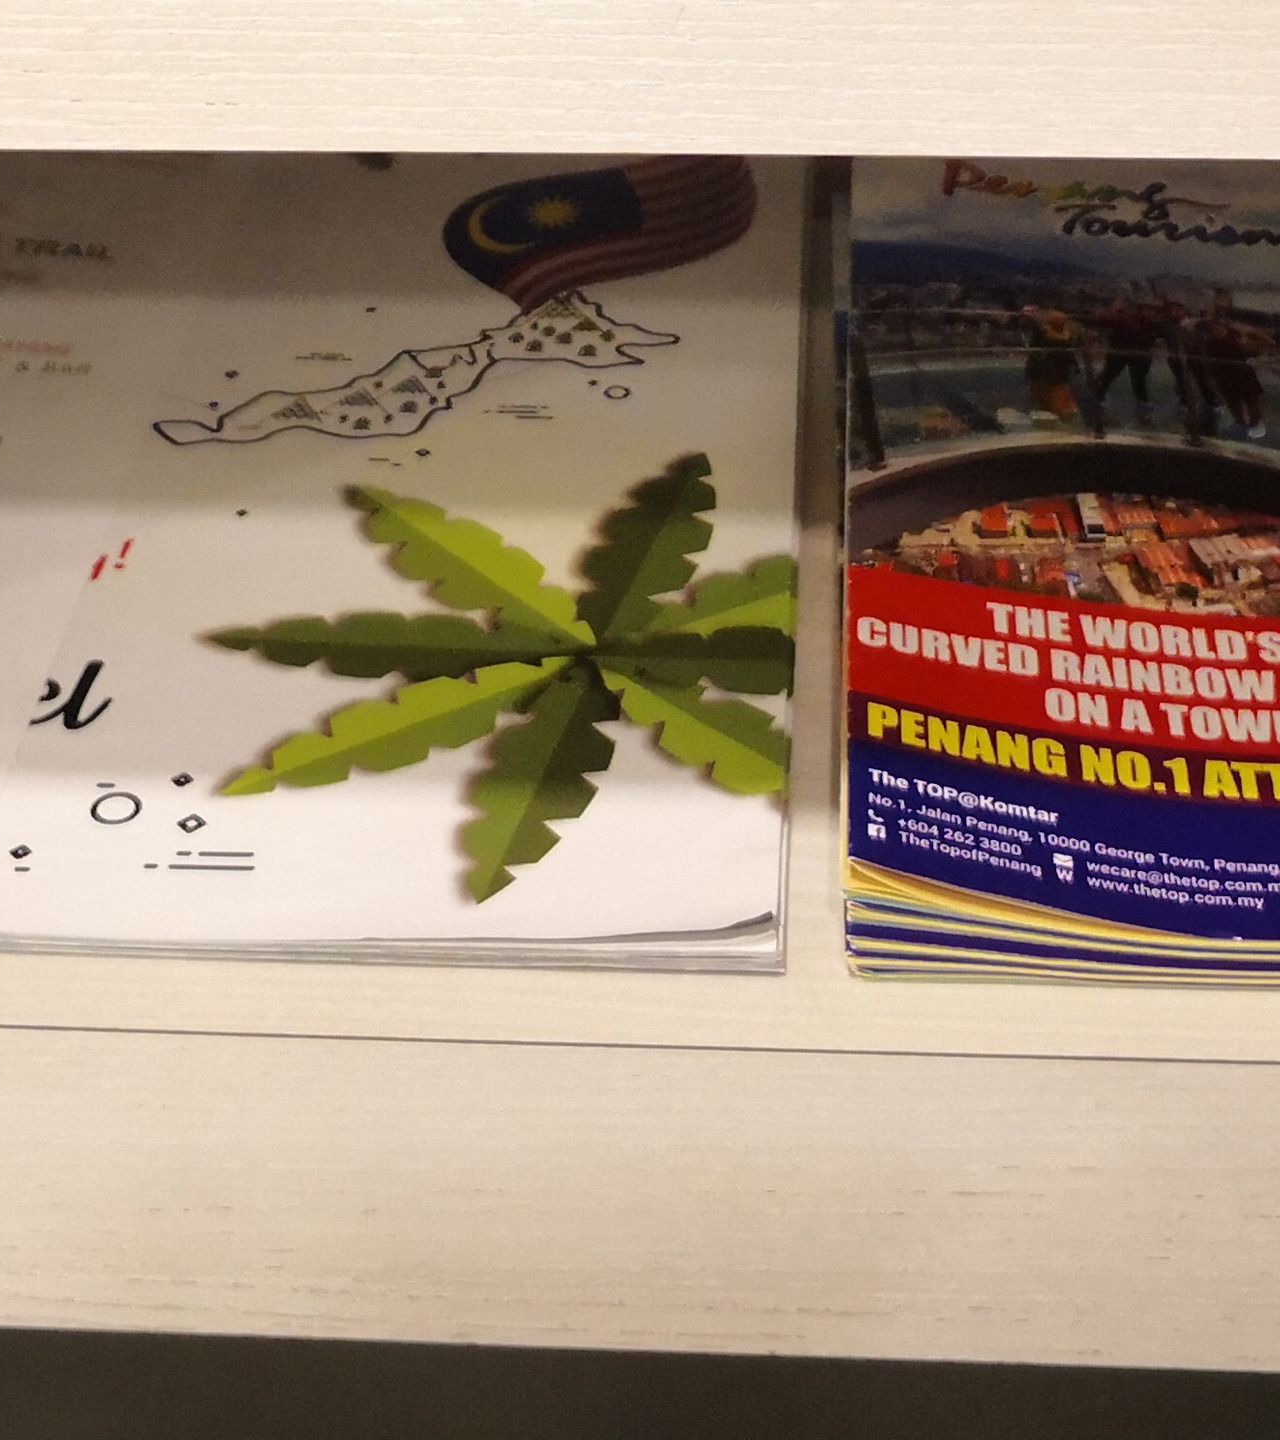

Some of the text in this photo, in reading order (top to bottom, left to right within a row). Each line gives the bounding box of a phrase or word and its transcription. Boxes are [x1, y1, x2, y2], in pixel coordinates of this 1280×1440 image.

[986, 600, 1071, 643] THE
[857, 616, 1040, 680] CURVED
[1050, 645, 1277, 704] RAINBOW
[1044, 688, 1111, 732] ON
[1120, 698, 1160, 735] A
[866, 702, 1067, 778] PENANG
[1081, 743, 1190, 799] NO.1
[869, 767, 1060, 826] The TOP@Komtar
[868, 791, 914, 815] No.1,
[916, 803, 963, 827] Jalan
[966, 815, 1034, 844] Penang,
[1038, 831, 1091, 853] 10000
[1095, 842, 1155, 865] George
[1159, 852, 1212, 873] Town,
[897, 817, 1023, 857] +604 262 3800
[898, 830, 1043, 879] TheTopofPenang
[1086, 874, 1266, 910] www.thetop.com.my
